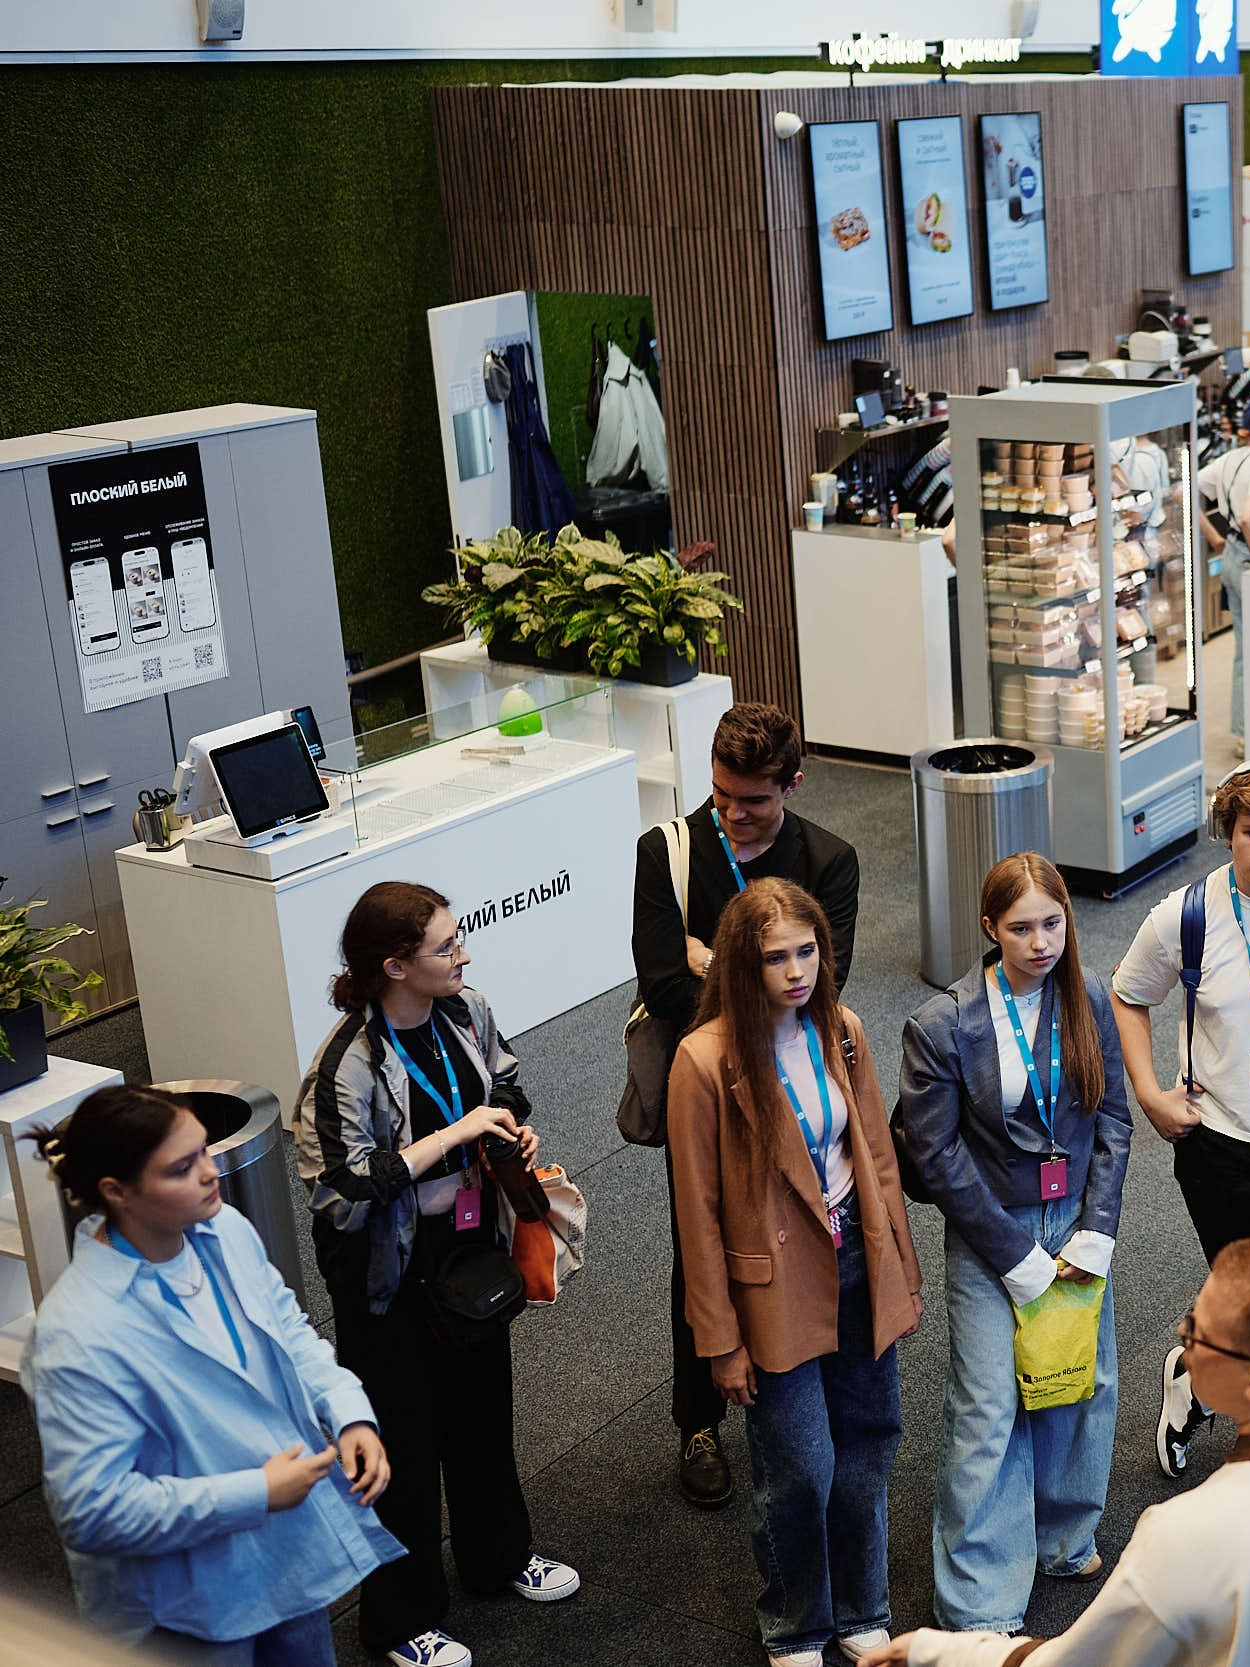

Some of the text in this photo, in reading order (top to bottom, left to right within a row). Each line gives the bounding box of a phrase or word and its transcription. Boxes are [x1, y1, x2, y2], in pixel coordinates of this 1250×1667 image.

[70, 471, 187, 506] ПЛОСКИЙ БЕЛЫЙ
[502, 869, 571, 919] БЕЛЫЙ
[1033, 1371, 1062, 1384] Золотое
